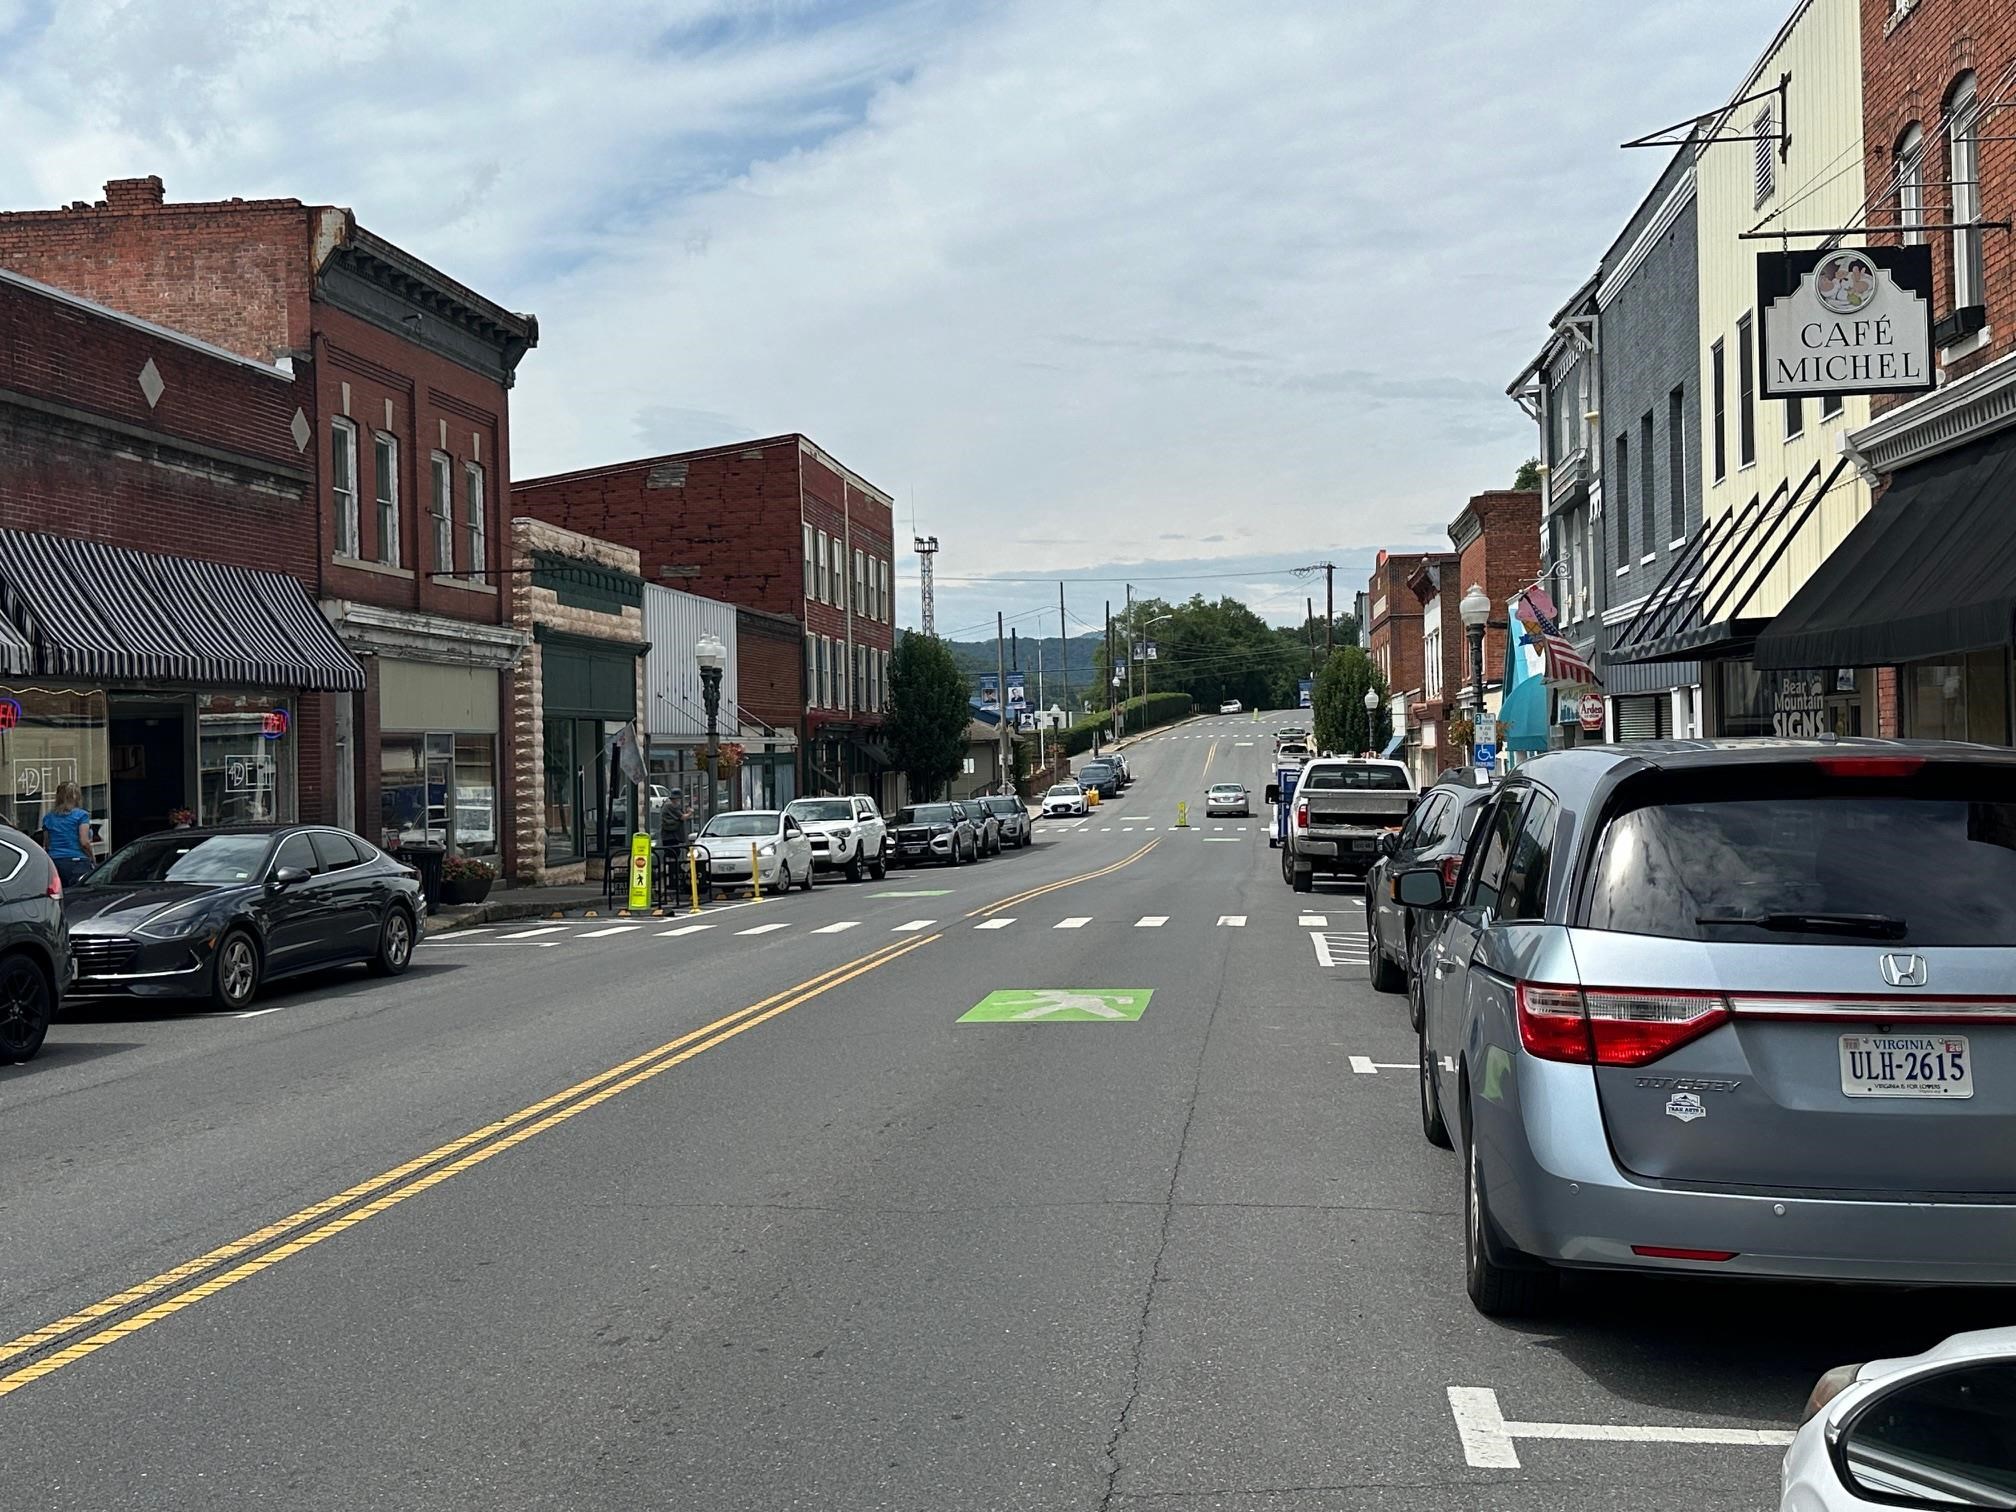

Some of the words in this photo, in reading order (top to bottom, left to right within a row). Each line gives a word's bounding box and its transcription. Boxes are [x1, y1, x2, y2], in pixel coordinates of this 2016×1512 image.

[1801, 314, 1894, 349] CAFÉ
[1777, 352, 1921, 384] MICHEL
[1783, 678, 1807, 695] Bear
[1580, 703, 1603, 715] Arden
[1774, 692, 1824, 711] Mountain
[1772, 711, 1825, 737] SIGNS
[1872, 1039, 1935, 1050] VIRGINIA
[1849, 1051, 1965, 1081] ULH-2615
[1634, 1076, 1742, 1093] ODYSSEY
